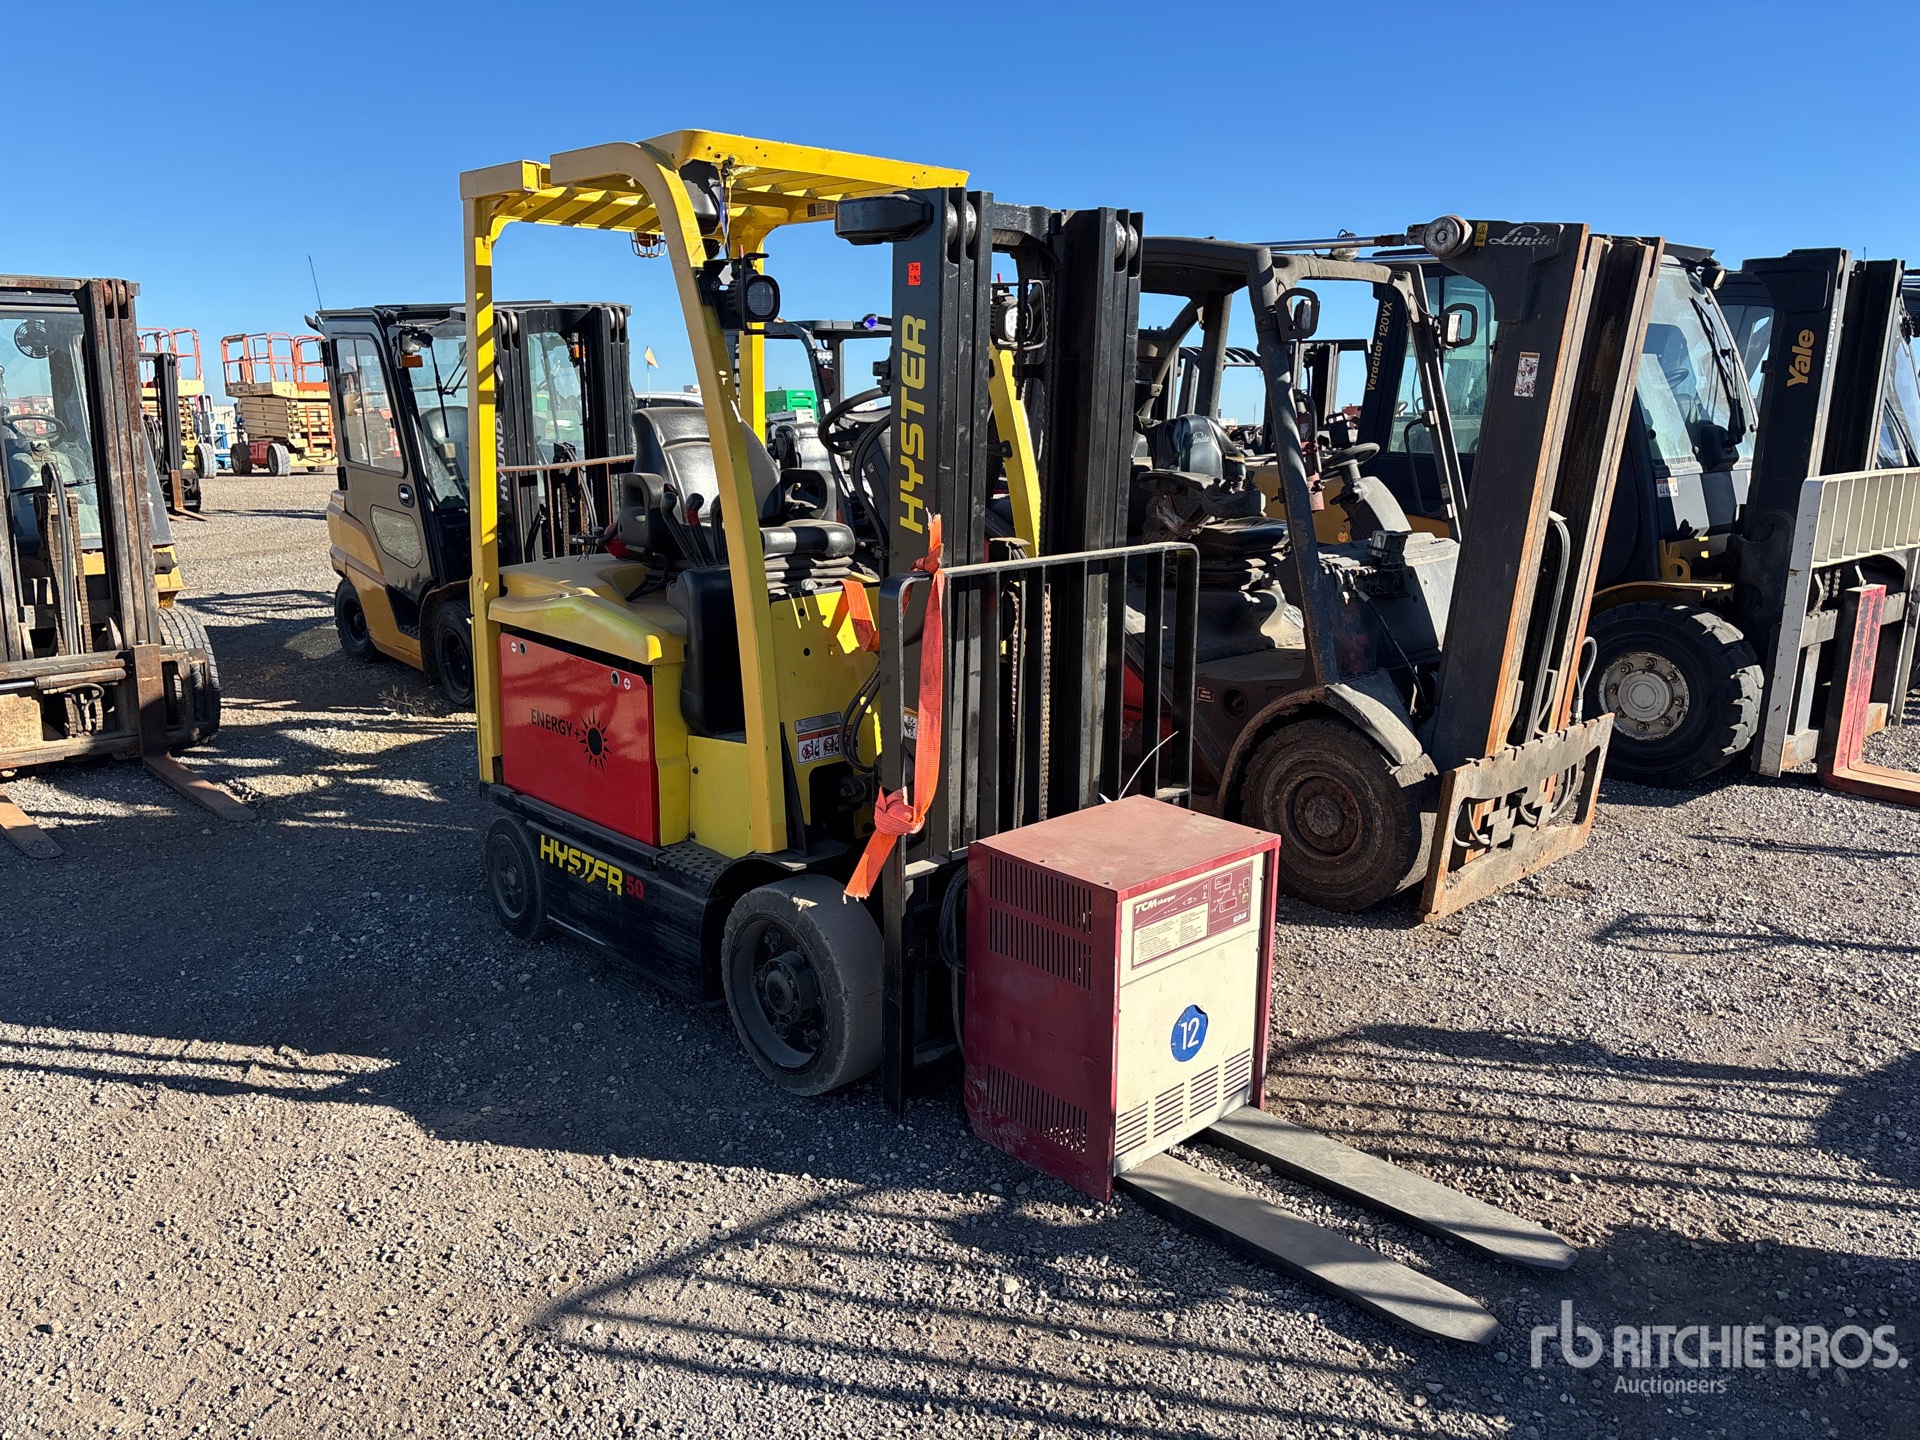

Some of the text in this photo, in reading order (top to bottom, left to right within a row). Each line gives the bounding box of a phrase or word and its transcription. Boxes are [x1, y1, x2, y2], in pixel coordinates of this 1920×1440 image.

[1366, 301, 1393, 391] Veracitor 120VX
[1786, 329, 1815, 387] Yale
[899, 314, 926, 535] HYSTER
[626, 875, 645, 899] 50
[1135, 898, 1158, 915] TCM
[1180, 1016, 1200, 1050] 12
